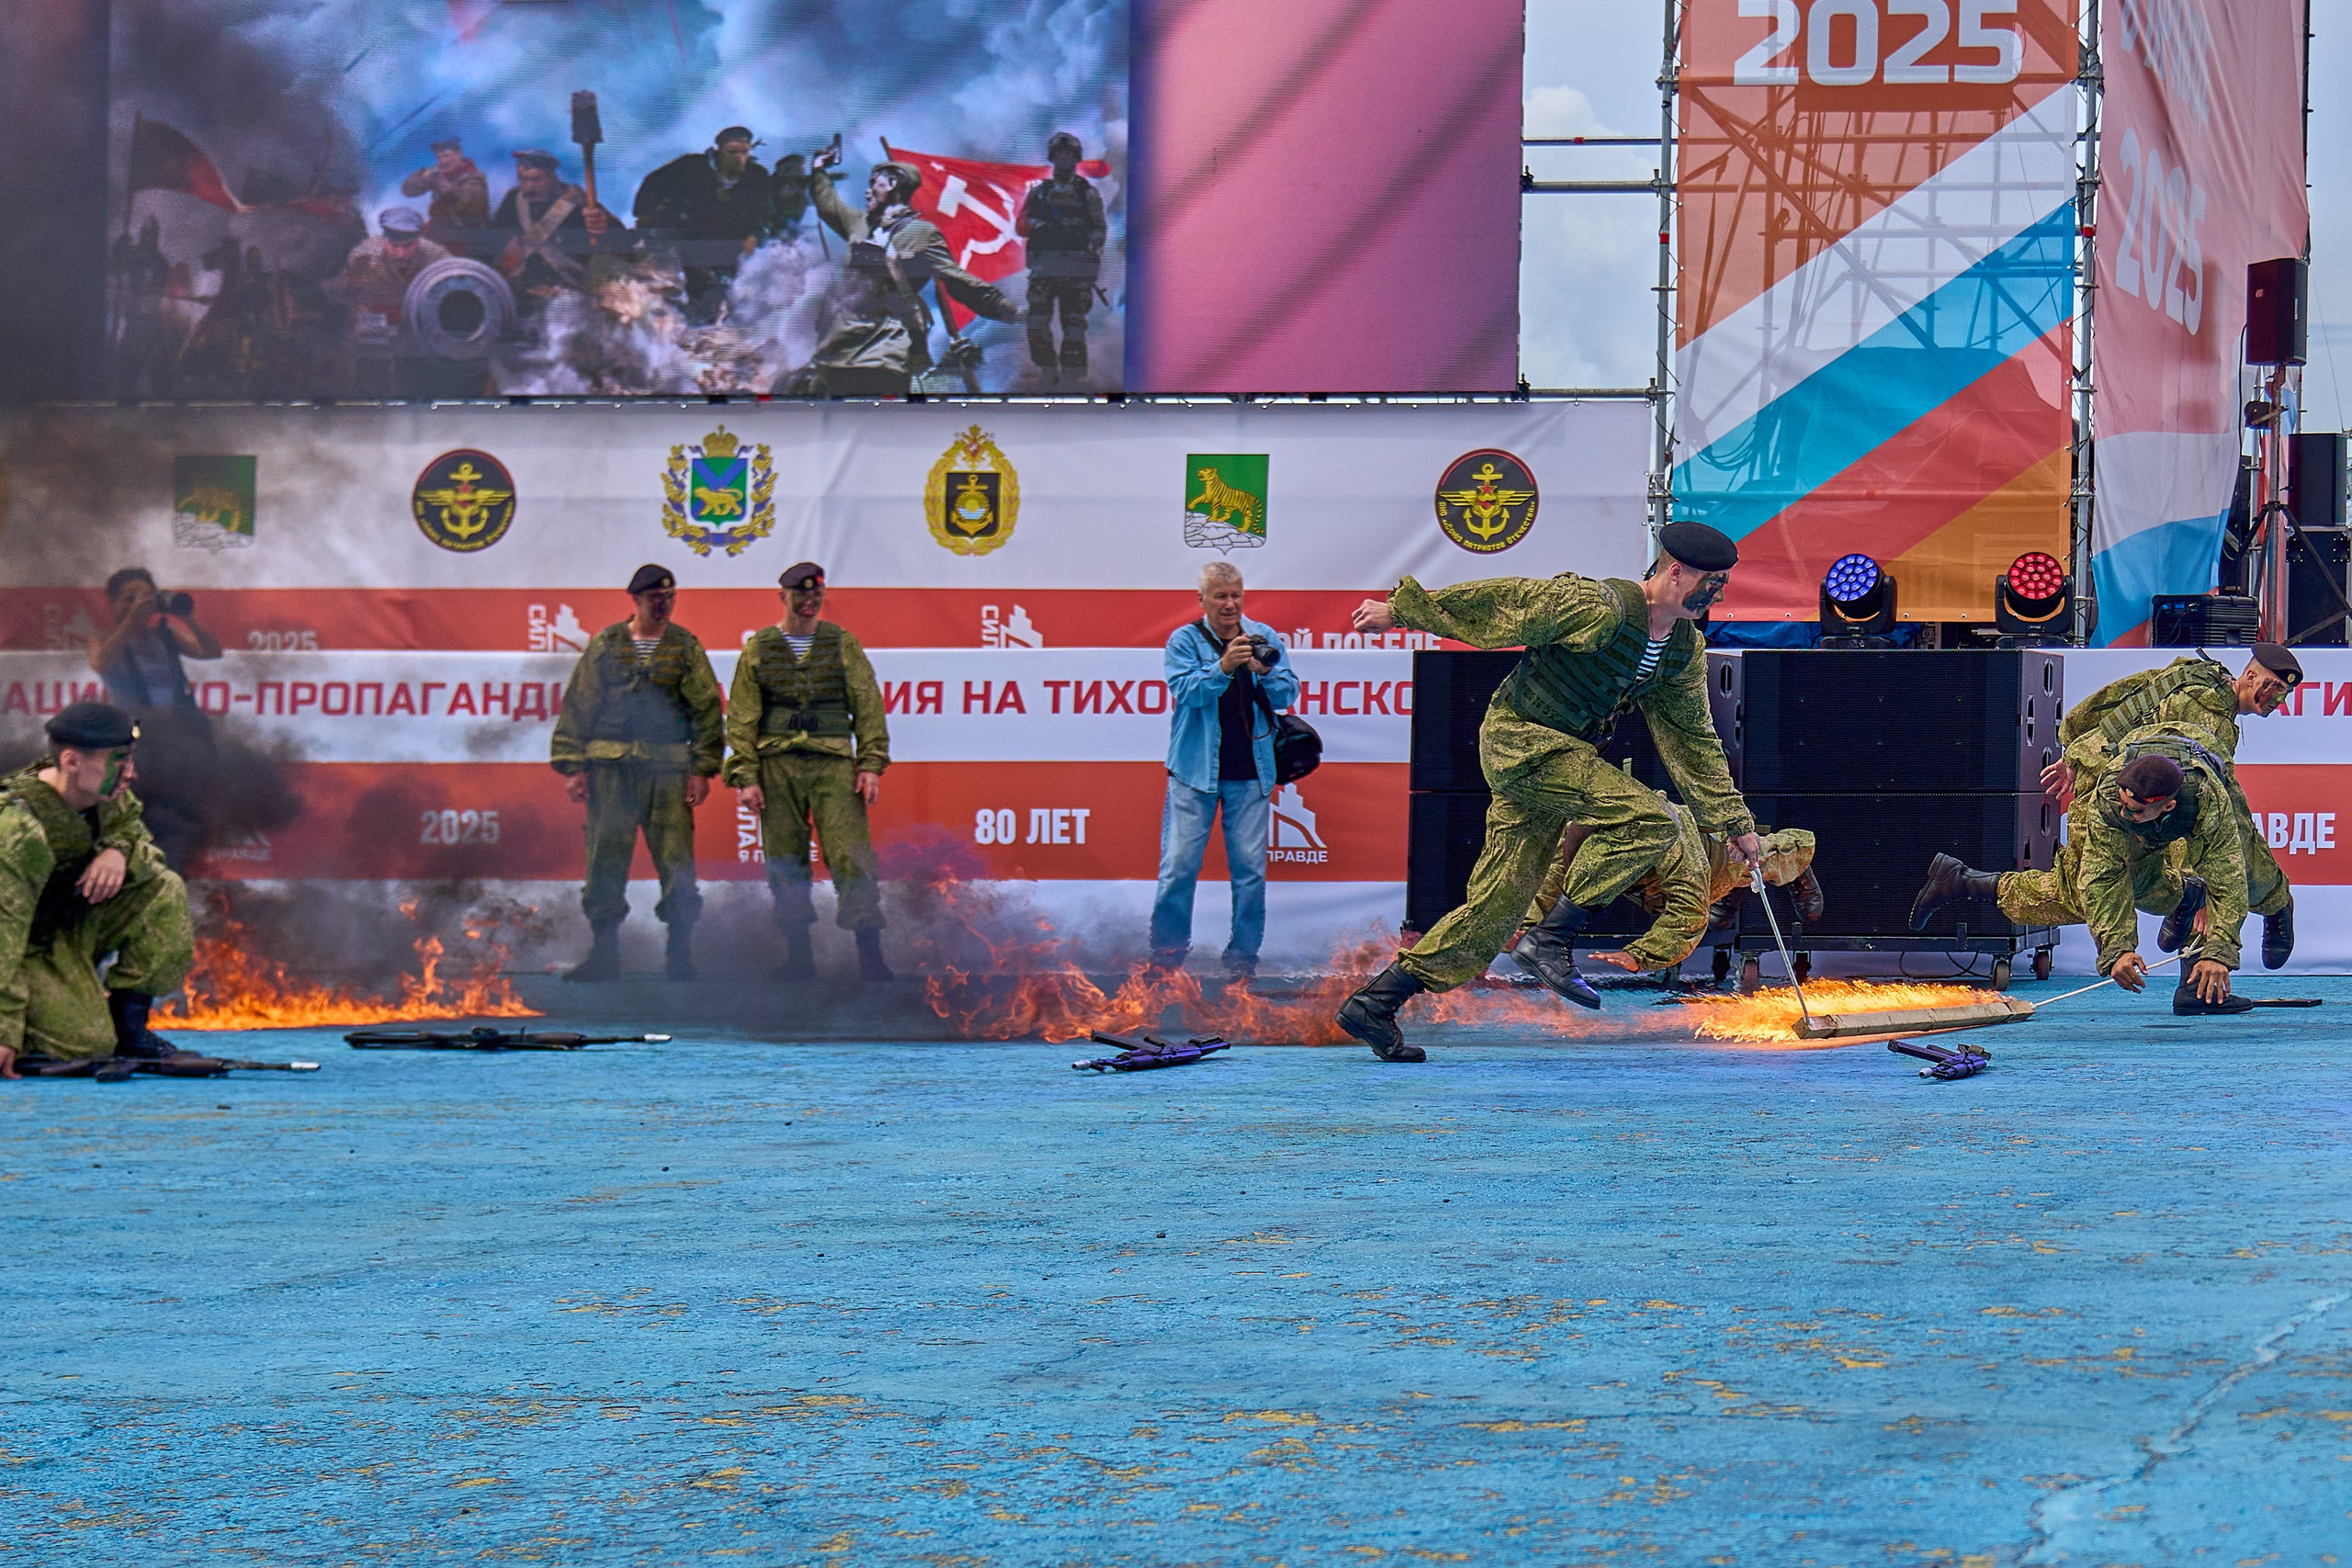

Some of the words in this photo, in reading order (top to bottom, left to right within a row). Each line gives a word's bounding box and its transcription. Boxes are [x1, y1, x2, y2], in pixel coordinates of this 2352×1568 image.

[1734, 0, 2023, 85] 2025
[2115, 127, 2206, 335] 2025
[962, 680, 1027, 715] НА
[420, 809, 500, 844] 2025
[975, 808, 1016, 845] 80
[1026, 808, 1091, 844] ЛЕТ
